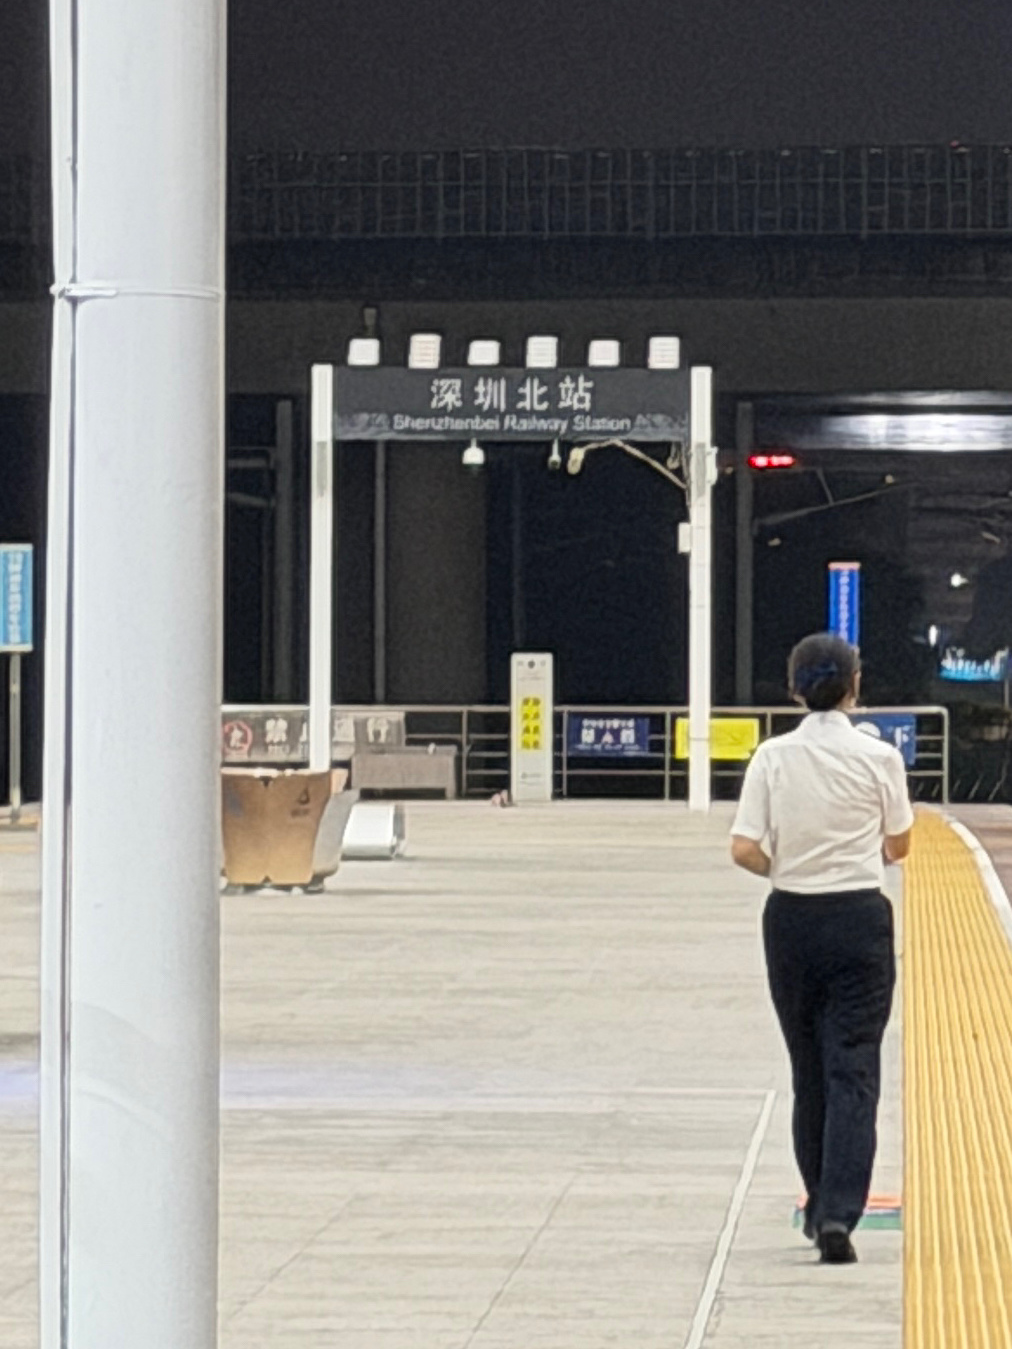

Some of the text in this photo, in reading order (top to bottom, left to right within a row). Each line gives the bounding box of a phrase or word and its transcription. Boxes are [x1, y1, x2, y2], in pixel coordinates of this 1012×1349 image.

[430, 374, 594, 412] 深圳北站
[392, 414, 632, 434] Shenzhenbei Railway Station
